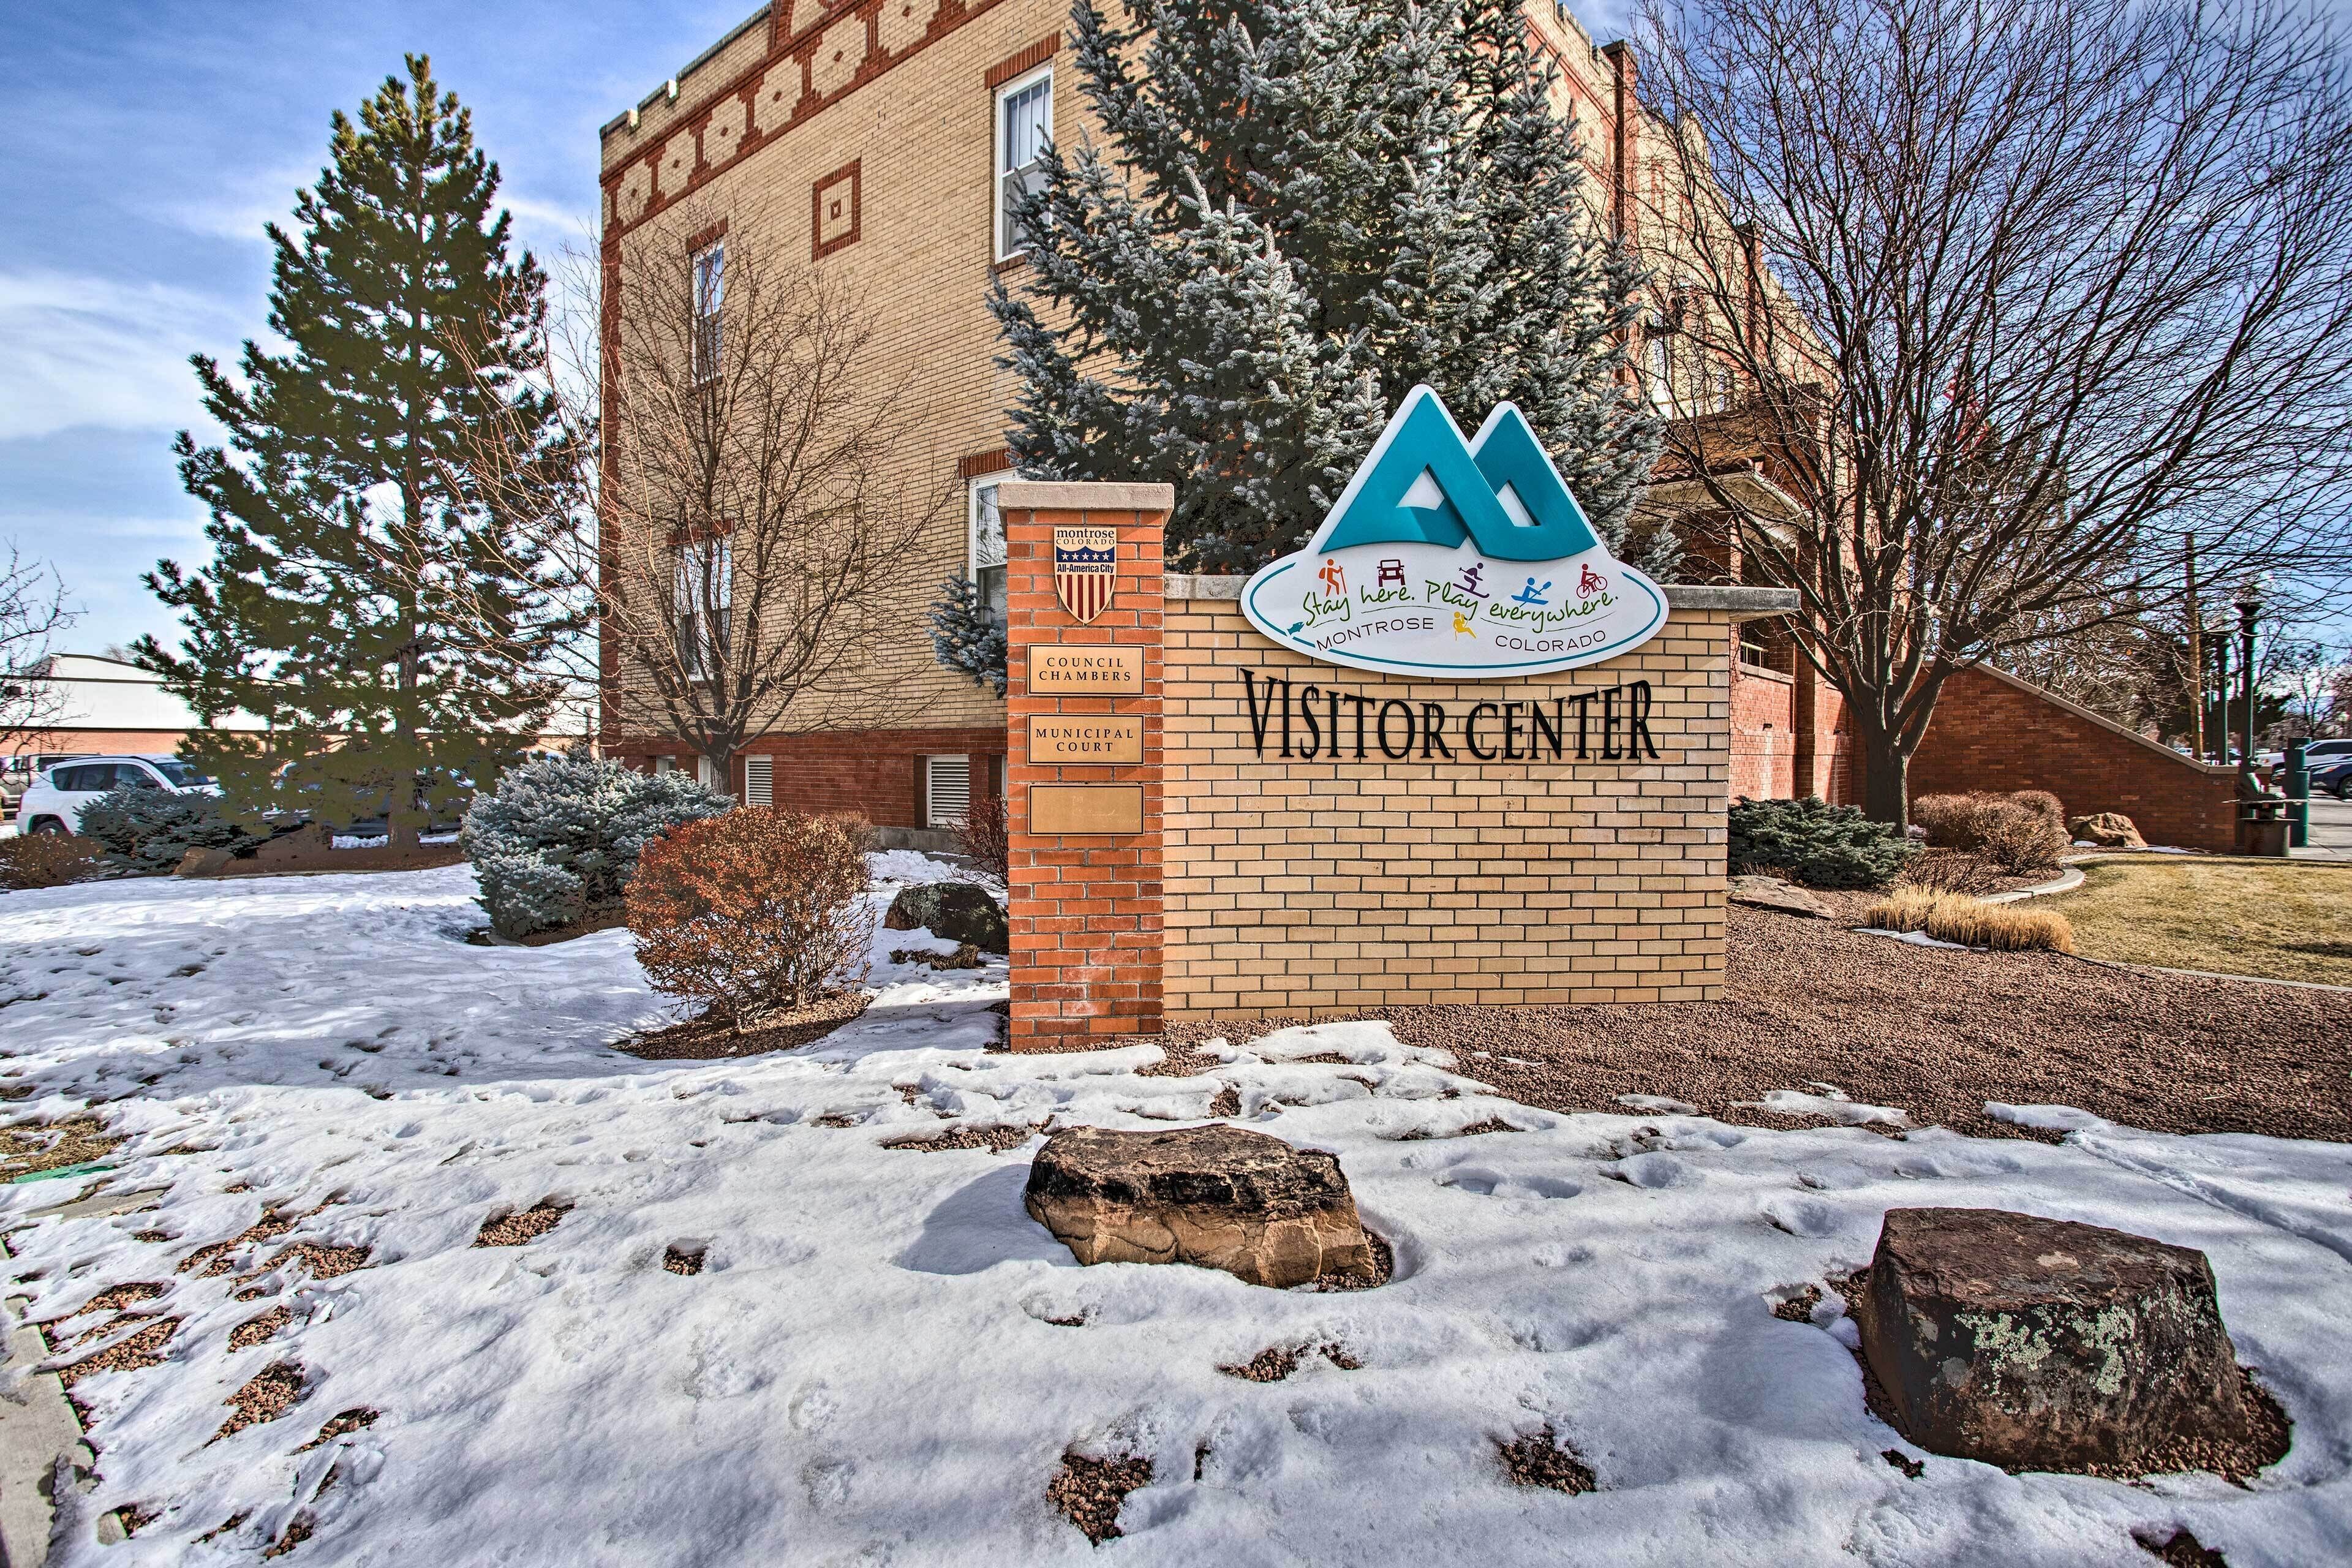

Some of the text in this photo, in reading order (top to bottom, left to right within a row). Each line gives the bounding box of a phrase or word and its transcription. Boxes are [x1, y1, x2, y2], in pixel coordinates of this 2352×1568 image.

[1057, 529, 1114, 538] montrose
[1057, 564, 1114, 573] All-America City
[1303, 579, 1619, 633] Stay here. Play everywhere.
[1316, 617, 1606, 652] MONTROSE COLORADO
[1047, 658, 1123, 667] COUNCIL
[1039, 671, 1131, 680] CHAMBERS
[1240, 668, 1660, 761] VISITOR CENTER
[1036, 729, 1133, 739] MUNICIPAL
[1057, 742, 1112, 751] COURT
